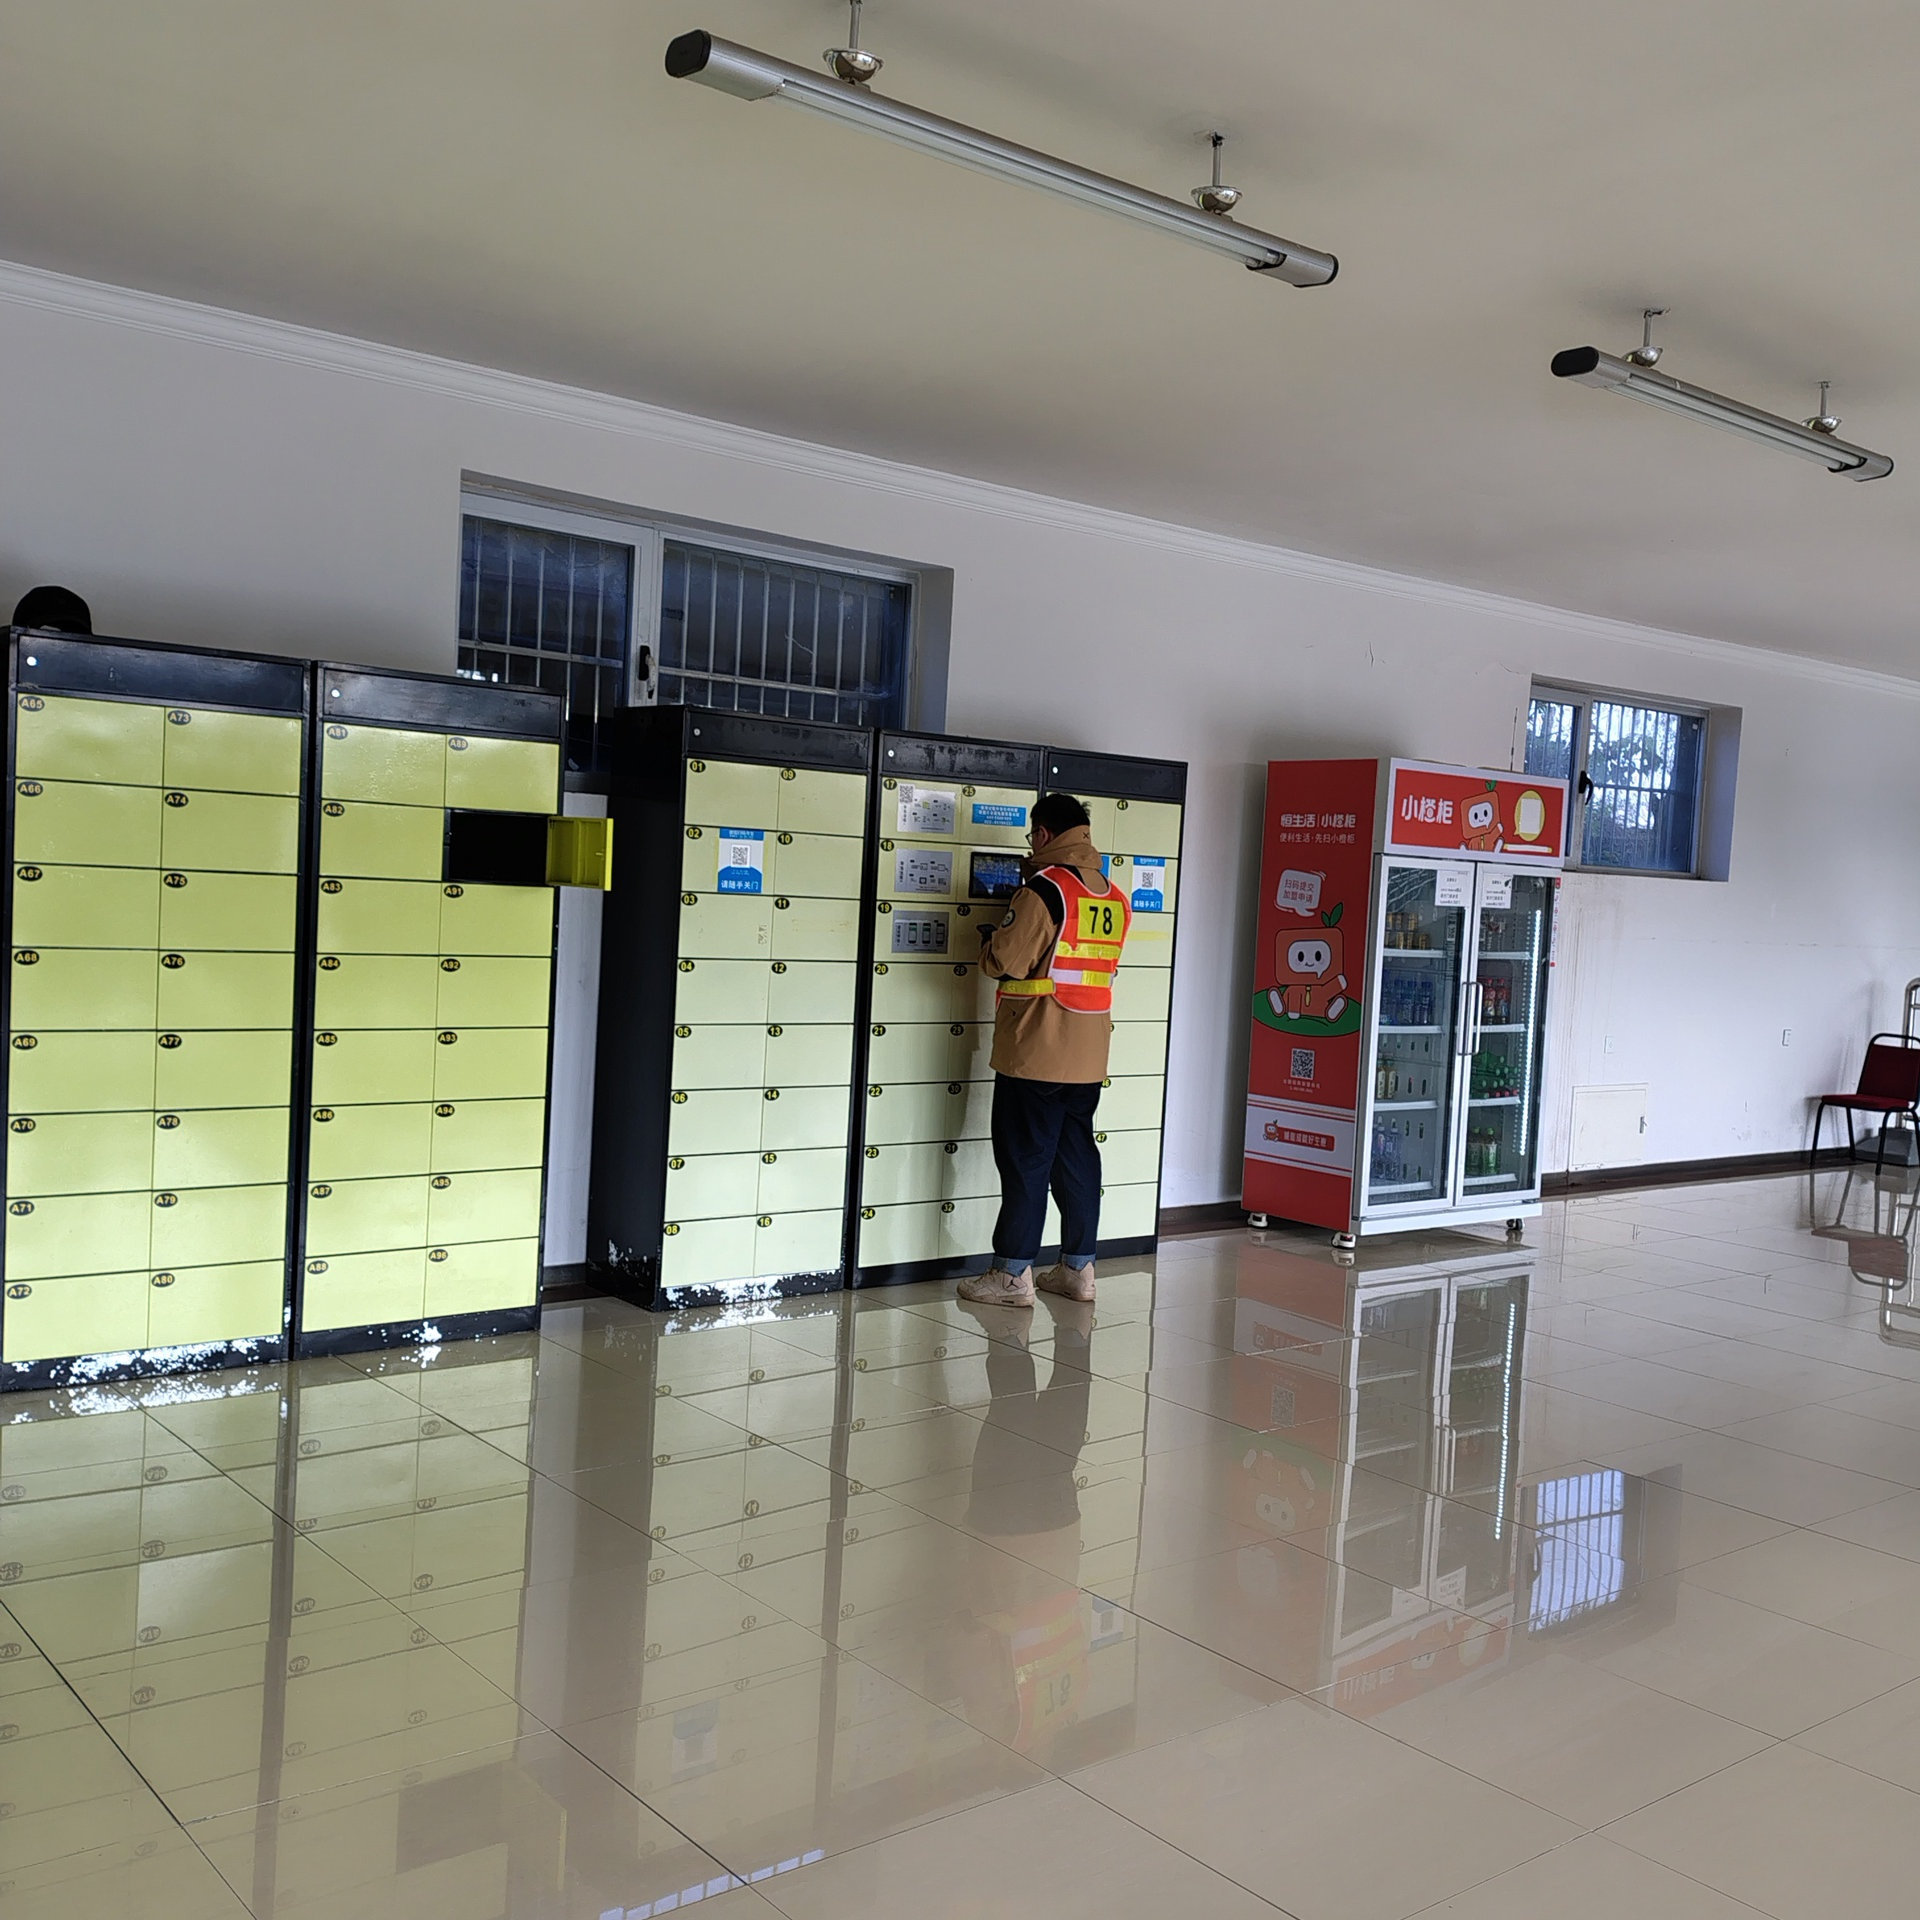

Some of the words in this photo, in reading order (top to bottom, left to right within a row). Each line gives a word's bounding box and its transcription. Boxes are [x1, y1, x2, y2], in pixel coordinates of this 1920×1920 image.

[21, 698, 43, 709] A65
[169, 712, 189, 722] A73
[328, 727, 346, 737] A81
[450, 738, 467, 748] A89
[692, 762, 703, 771] 01
[783, 770, 793, 779] 09
[20, 784, 41, 794] A66
[886, 780, 895, 789] 17
[964, 787, 974, 796] 25
[167, 795, 186, 805] A74
[325, 805, 343, 814] A82
[1118, 801, 1126, 809] 41
[1401, 795, 1453, 825] 小橙柜
[1321, 813, 1356, 828] 小橙柜
[688, 828, 700, 838] 02
[780, 835, 790, 844] 10
[883, 841, 892, 850] 18
[1114, 857, 1122, 865] 42
[19, 868, 40, 878] A67
[165, 875, 186, 885] A75
[323, 882, 341, 891] A83
[721, 880, 759, 890] 请随手关门
[445, 887, 462, 896] A91
[684, 895, 695, 904] 03
[777, 899, 787, 908] 11
[880, 904, 890, 912] 19
[1089, 905, 1112, 935] 78
[16, 953, 37, 962] A68
[163, 956, 183, 966] A76
[320, 959, 339, 968] A84
[442, 961, 459, 970] A92
[681, 962, 692, 971] 04
[774, 963, 784, 973] 12
[876, 965, 886, 973] 20
[678, 1027, 689, 1037] 05
[770, 1027, 780, 1036] 13
[874, 1026, 883, 1035] 21
[14, 1037, 36, 1047] A69
[160, 1036, 180, 1046] A77
[318, 1035, 336, 1044] A85
[439, 1034, 456, 1042] A93
[767, 1090, 777, 1099] 14
[870, 1086, 880, 1096] 22
[674, 1093, 685, 1102] 06
[315, 1111, 333, 1119] A86
[12, 1120, 34, 1130] A70
[158, 1117, 178, 1126] A78
[867, 1148, 877, 1157] 23
[764, 1154, 774, 1163] 15
[671, 1159, 682, 1168] 07
[433, 1178, 450, 1187] A95
[312, 1187, 330, 1196] A87
[156, 1195, 176, 1205] A79
[11, 1203, 32, 1213] A71
[944, 1203, 953, 1212] 32
[862, 1209, 873, 1218] 24
[758, 1217, 770, 1226] 16
[666, 1225, 677, 1234] 08
[430, 1251, 447, 1260] A96
[309, 1262, 327, 1272] A88
[153, 1275, 173, 1284] A80
[9, 1286, 30, 1296] A72
